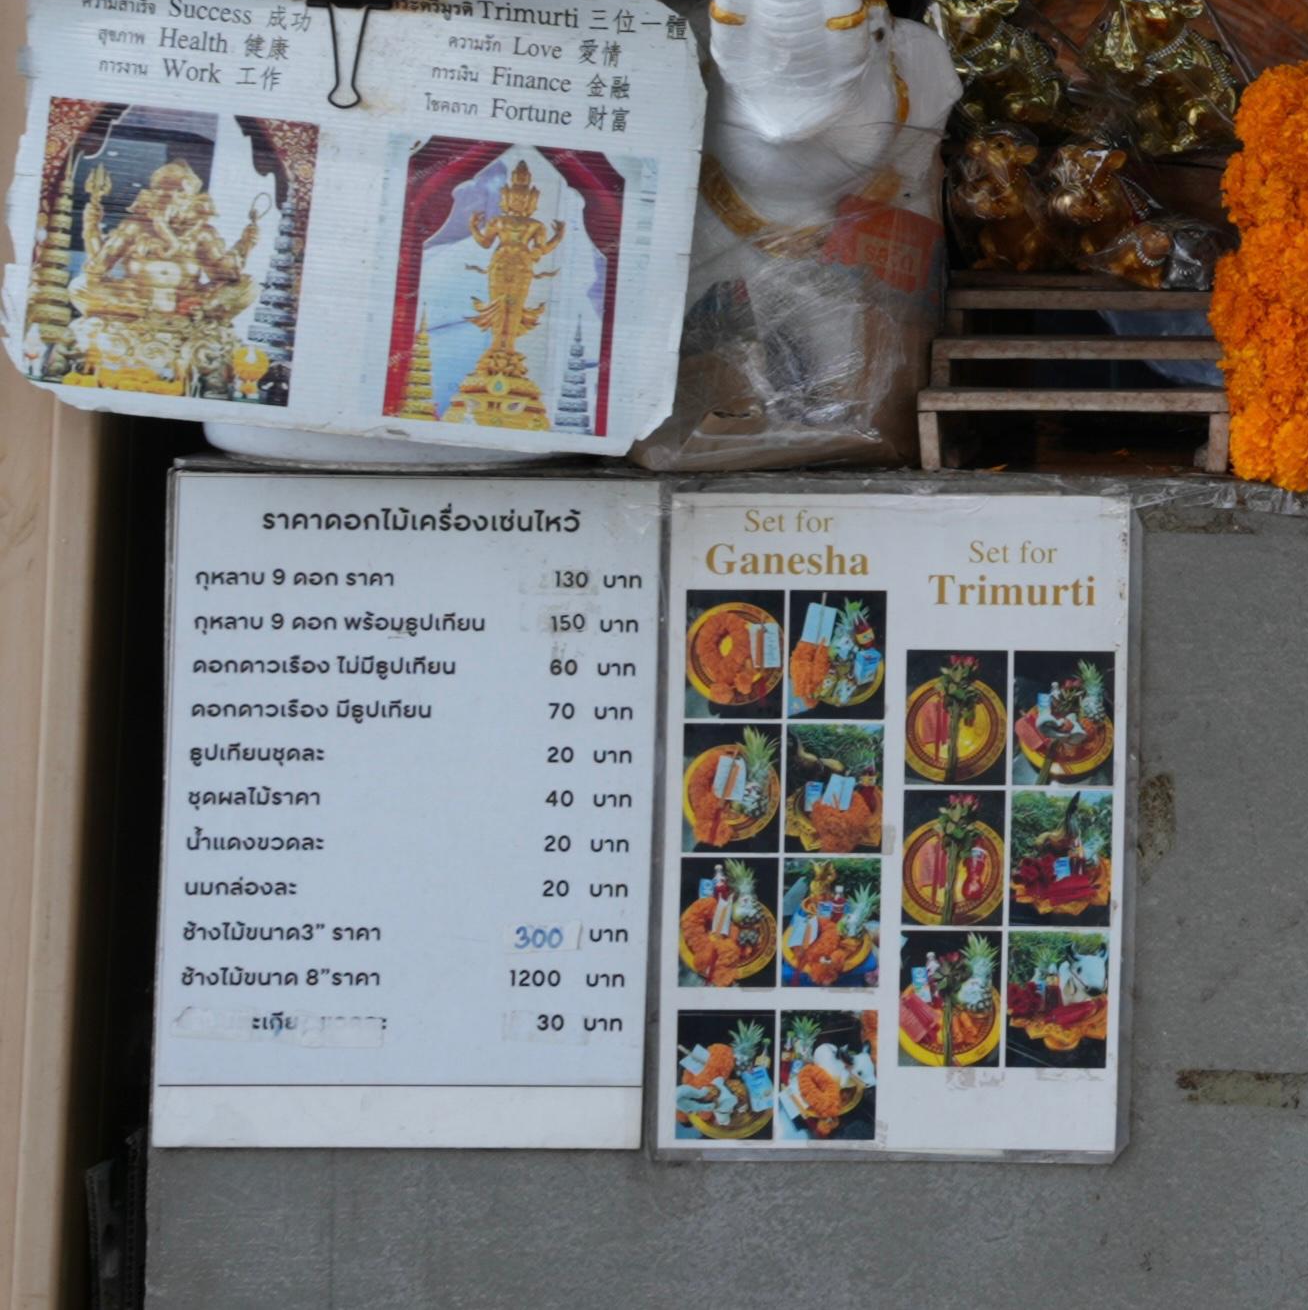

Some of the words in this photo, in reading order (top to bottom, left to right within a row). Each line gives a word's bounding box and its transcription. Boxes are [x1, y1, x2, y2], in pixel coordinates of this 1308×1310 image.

[266, 6, 312, 32] 成功
[158, 26, 228, 54] Health
[243, 33, 290, 61] 健康
[512, 36, 563, 60] Love
[162, 57, 222, 84] Work
[235, 65, 283, 92] 工作
[491, 65, 572, 94] Finance
[586, 73, 631, 100] 金融
[490, 97, 573, 126] Fortune
[744, 510, 785, 533] Set
[796, 509, 833, 533] for
[705, 544, 869, 576] Ganesha
[968, 539, 1010, 563] Set
[1019, 540, 1057, 564] for
[272, 568, 286, 586] 9
[553, 570, 589, 589] 130
[603, 574, 643, 589] บาท
[928, 574, 1096, 608] Trimurti
[270, 612, 285, 631] 9
[549, 613, 586, 632] 150
[599, 618, 639, 634] บาท
[549, 658, 578, 677] 60
[597, 662, 636, 677] บาท
[548, 702, 576, 720] 70
[594, 705, 634, 721] บาท
[546, 745, 575, 764] 20
[593, 749, 633, 764] บาท
[514, 926, 564, 949] 300
[589, 928, 629, 943] บาท
[509, 969, 561, 988] 1200
[585, 973, 626, 988] บาท
